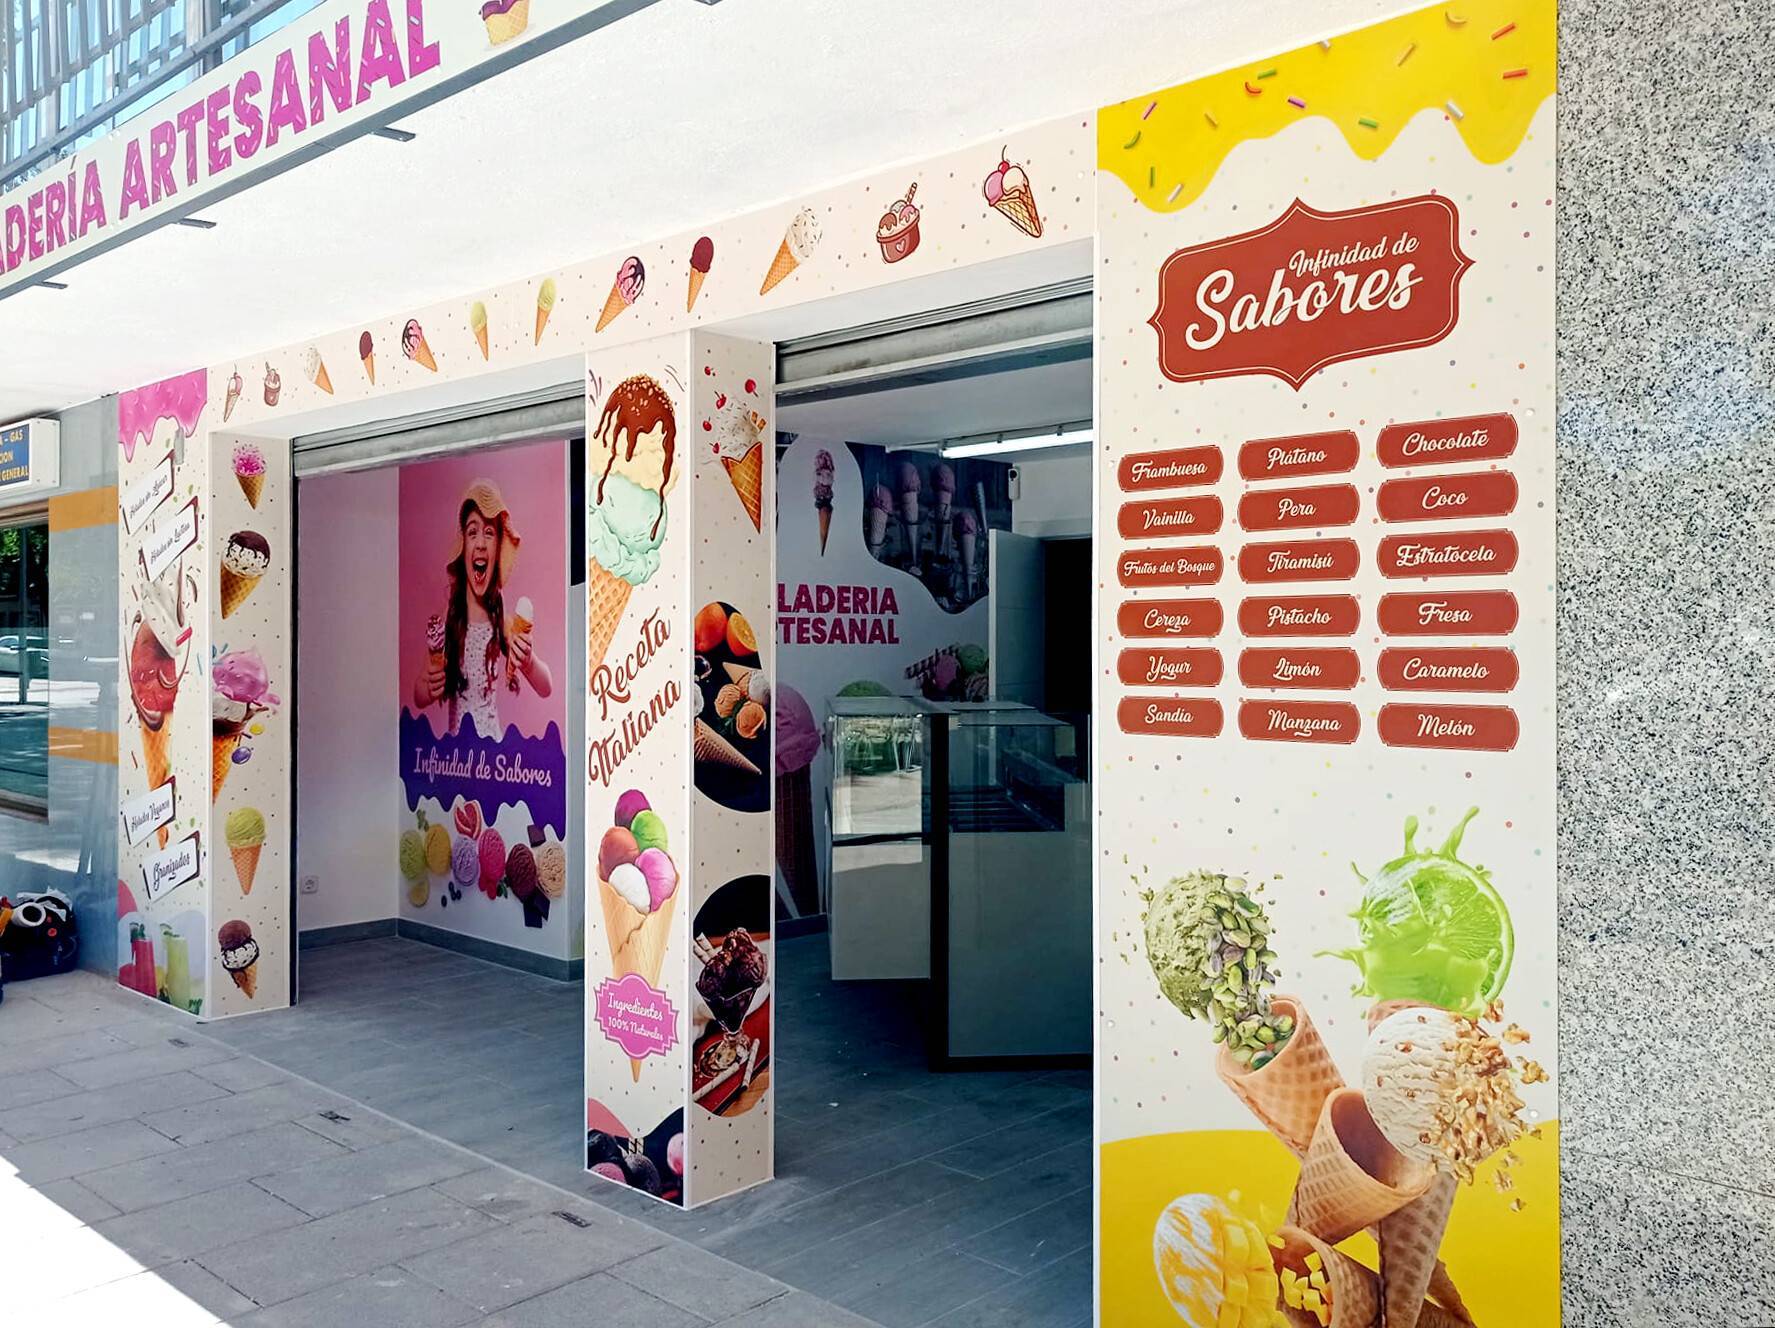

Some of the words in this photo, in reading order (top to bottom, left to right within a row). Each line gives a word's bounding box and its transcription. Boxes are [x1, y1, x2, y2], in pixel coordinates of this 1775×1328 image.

[0, 156, 107, 276] DERÍA
[119, 0, 441, 220] ARTESANAL
[1288, 235, 1388, 277] Infinidad
[1391, 231, 1420, 257] de
[1184, 263, 1424, 351] Sabores
[1402, 429, 1489, 456] Chocolate
[1131, 460, 1208, 482] Frambuesa
[1266, 447, 1327, 470] Plátano
[1278, 498, 1316, 520] Pera
[1421, 486, 1469, 510] Coco
[1142, 508, 1196, 529] Vainilla
[1124, 560, 1157, 577] Frutos
[1159, 561, 1175, 574] del
[1177, 558, 1215, 576] Bosque
[1266, 549, 1335, 573] Tiramisú
[1395, 543, 1497, 567] Estratocela
[777, 583, 899, 615] LADERIA
[1144, 608, 1191, 633] Cereza
[1267, 605, 1333, 628] Pistacho
[1418, 600, 1473, 625] Fresa
[776, 616, 899, 645] TESANAL
[590, 606, 670, 721] Receta
[1146, 655, 1192, 682] Yogur
[1272, 657, 1323, 681] Limón
[1402, 657, 1490, 681] Caramelo
[588, 680, 681, 787] Italiana
[1267, 708, 1342, 737] Manzana
[1417, 713, 1476, 738] Melón
[413, 746, 472, 783] Infinidad
[475, 750, 491, 780] de
[494, 752, 552, 787] Sabores
[608, 992, 663, 1021] Ingredientes
[608, 1016, 629, 1032] 100%
[630, 1021, 663, 1041] Naturales
